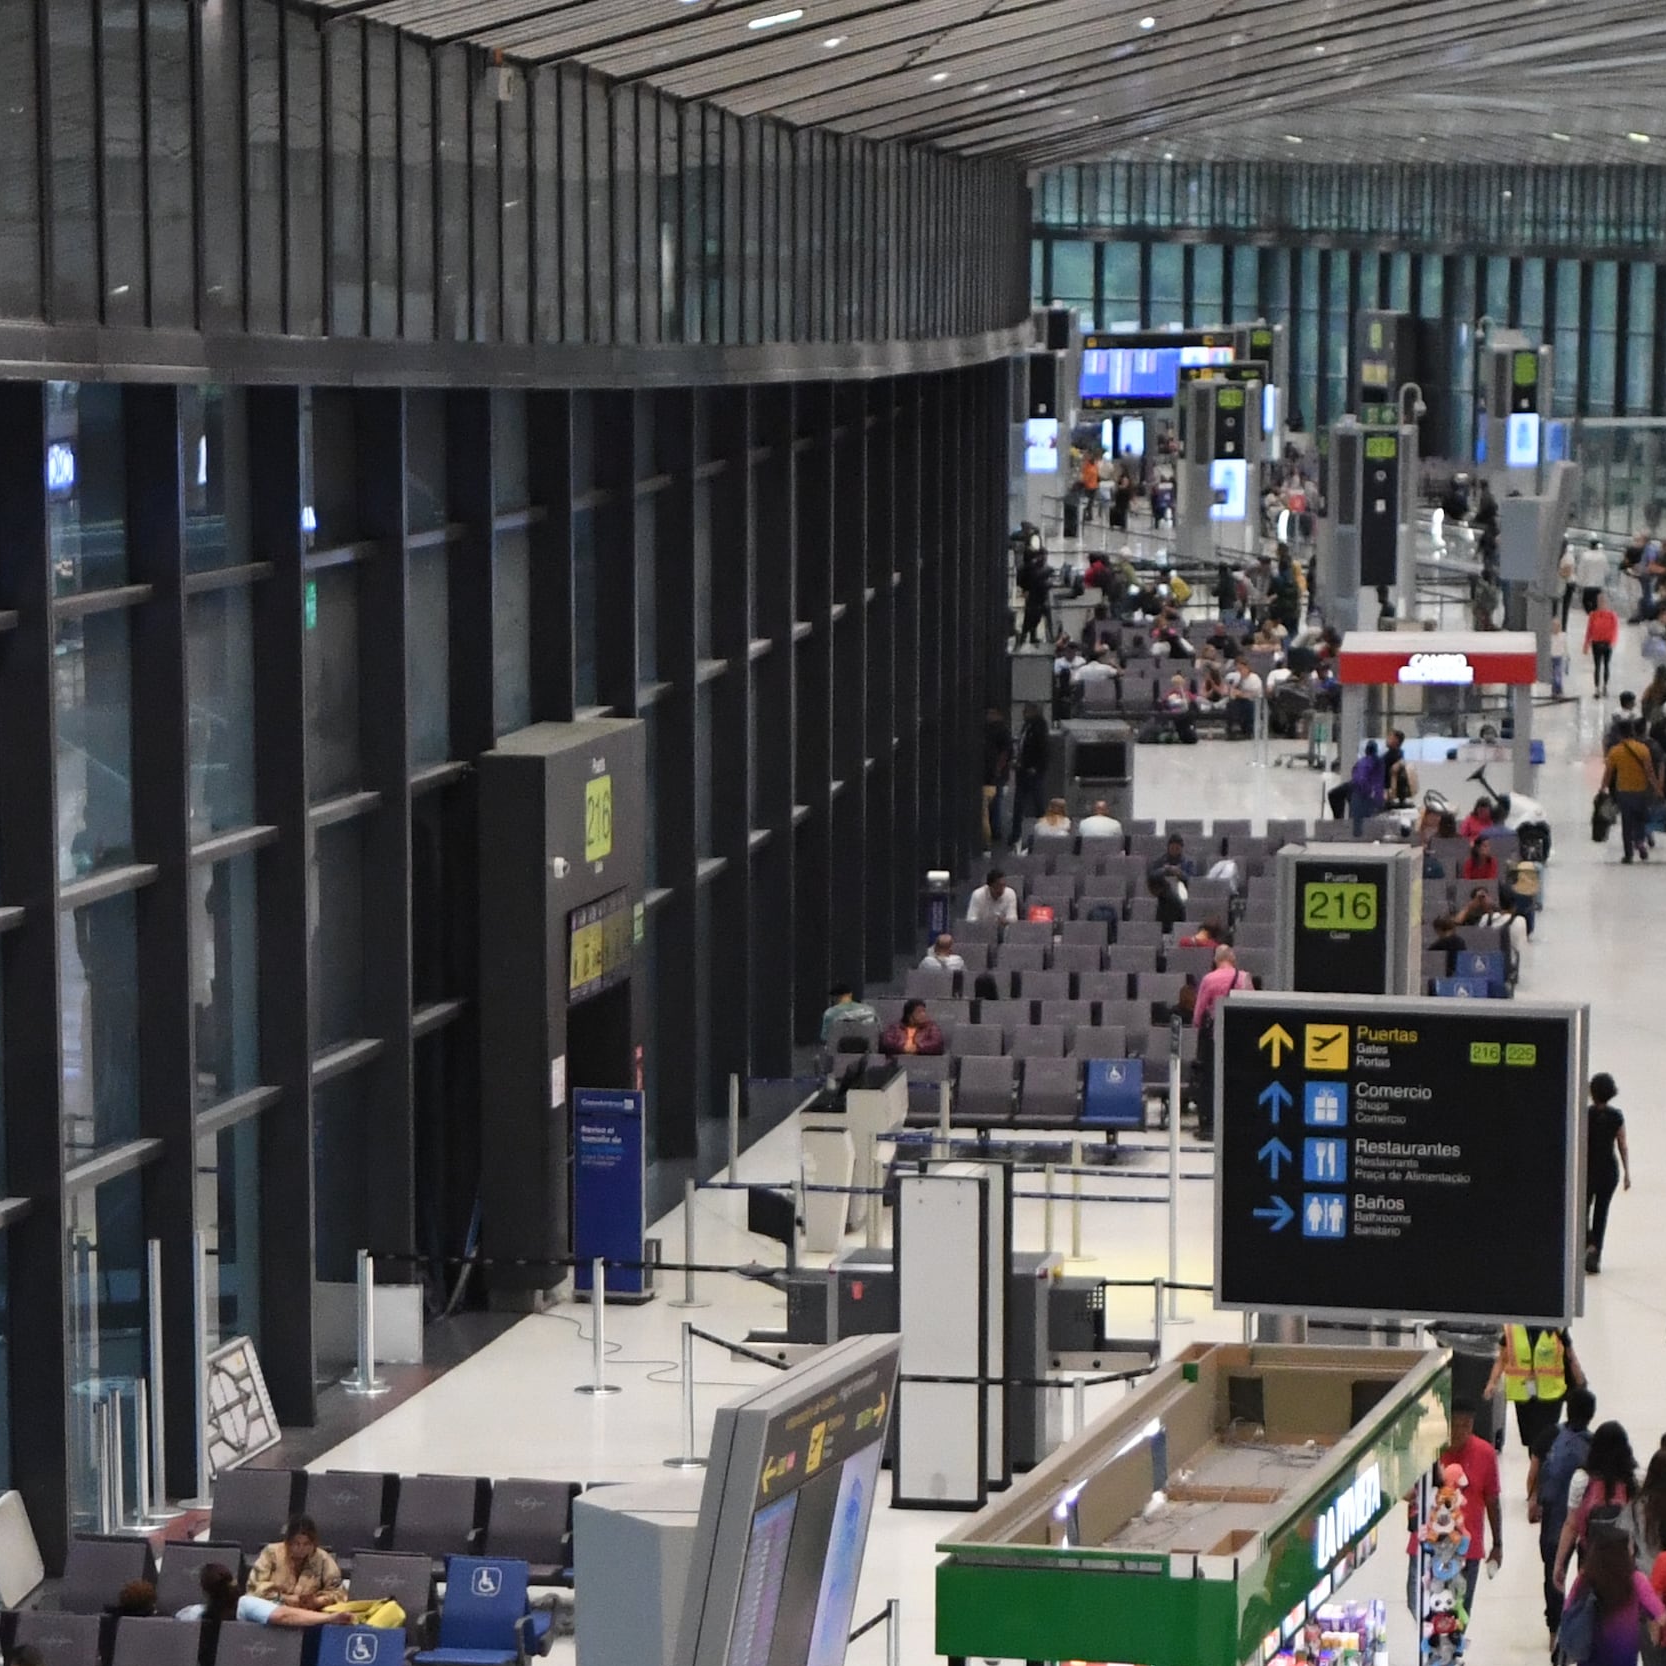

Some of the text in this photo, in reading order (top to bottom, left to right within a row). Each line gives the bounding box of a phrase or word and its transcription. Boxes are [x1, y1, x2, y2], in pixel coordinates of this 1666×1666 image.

[587, 790, 610, 847] 216
[1310, 891, 1371, 920] 216
[1357, 1025, 1418, 1043] Puertas
[1356, 1043, 1388, 1055] Gates
[1472, 1046, 1499, 1060] 216
[1356, 1056, 1391, 1068] Portas
[1356, 1082, 1433, 1100] Comercio
[1356, 1100, 1390, 1112] Shops
[1356, 1138, 1461, 1157] Restaurantes
[1355, 1156, 1419, 1168] Restaurants
[1388, 1170, 1402, 1181] de
[1354, 1193, 1405, 1211] Baños
[1354, 1212, 1411, 1224] Bathrooms
